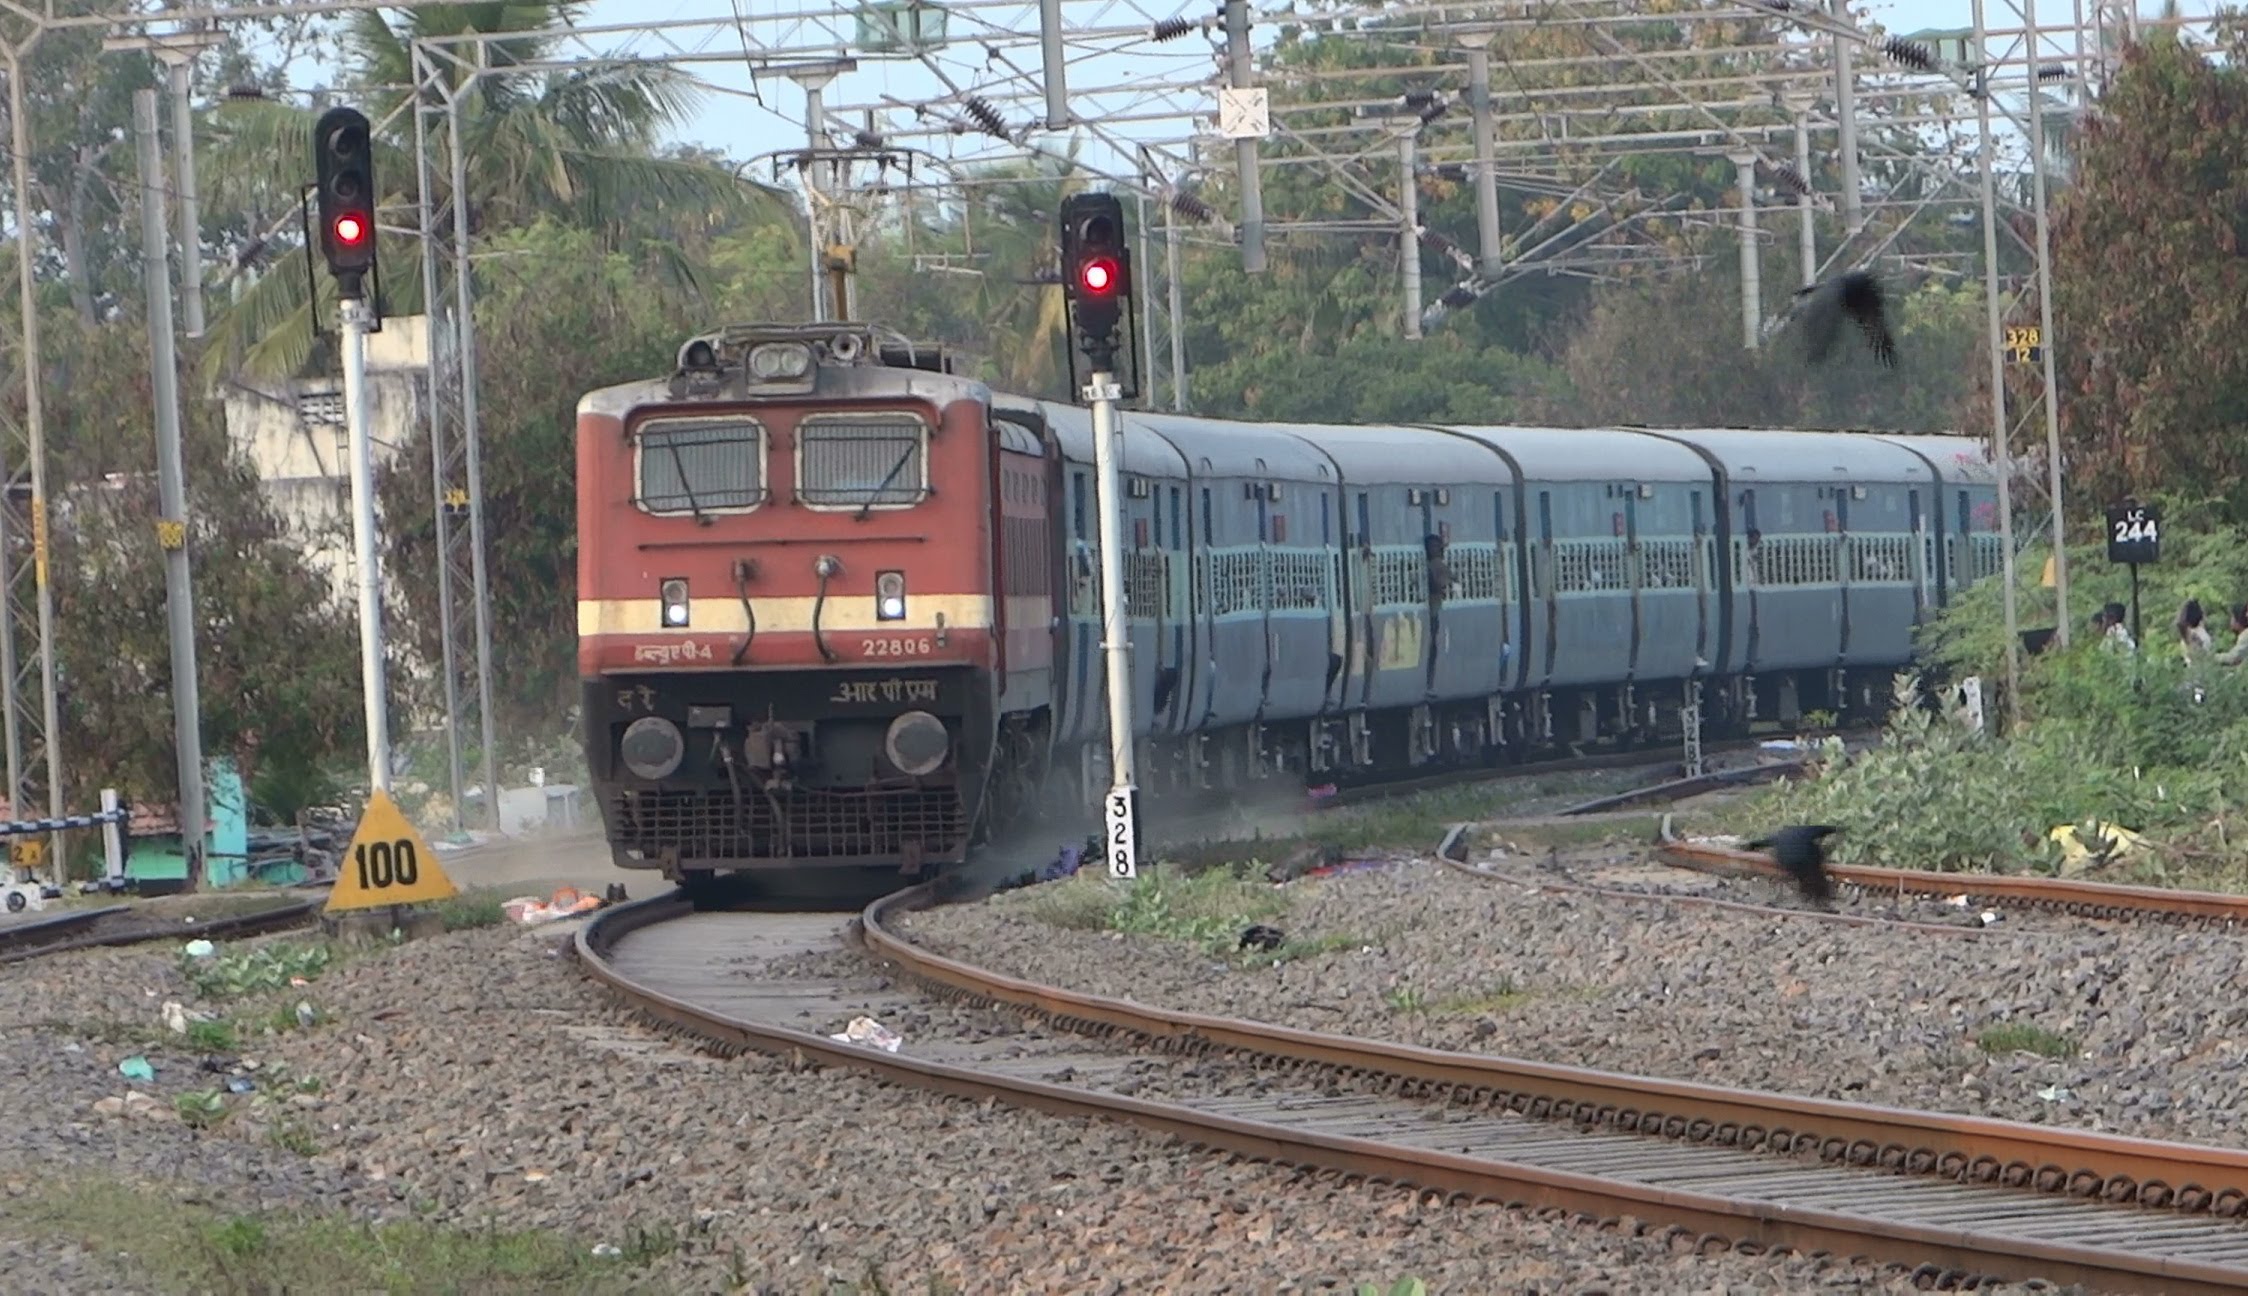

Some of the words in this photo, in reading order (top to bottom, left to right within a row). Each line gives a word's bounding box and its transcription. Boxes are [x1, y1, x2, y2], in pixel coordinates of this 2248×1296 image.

[2007, 328, 2039, 345] 328
[2127, 509, 2145, 521] LC
[2115, 520, 2157, 542] 244
[862, 638, 930, 655] 22806
[1113, 796, 1129, 876] 328
[355, 839, 418, 890] 100
